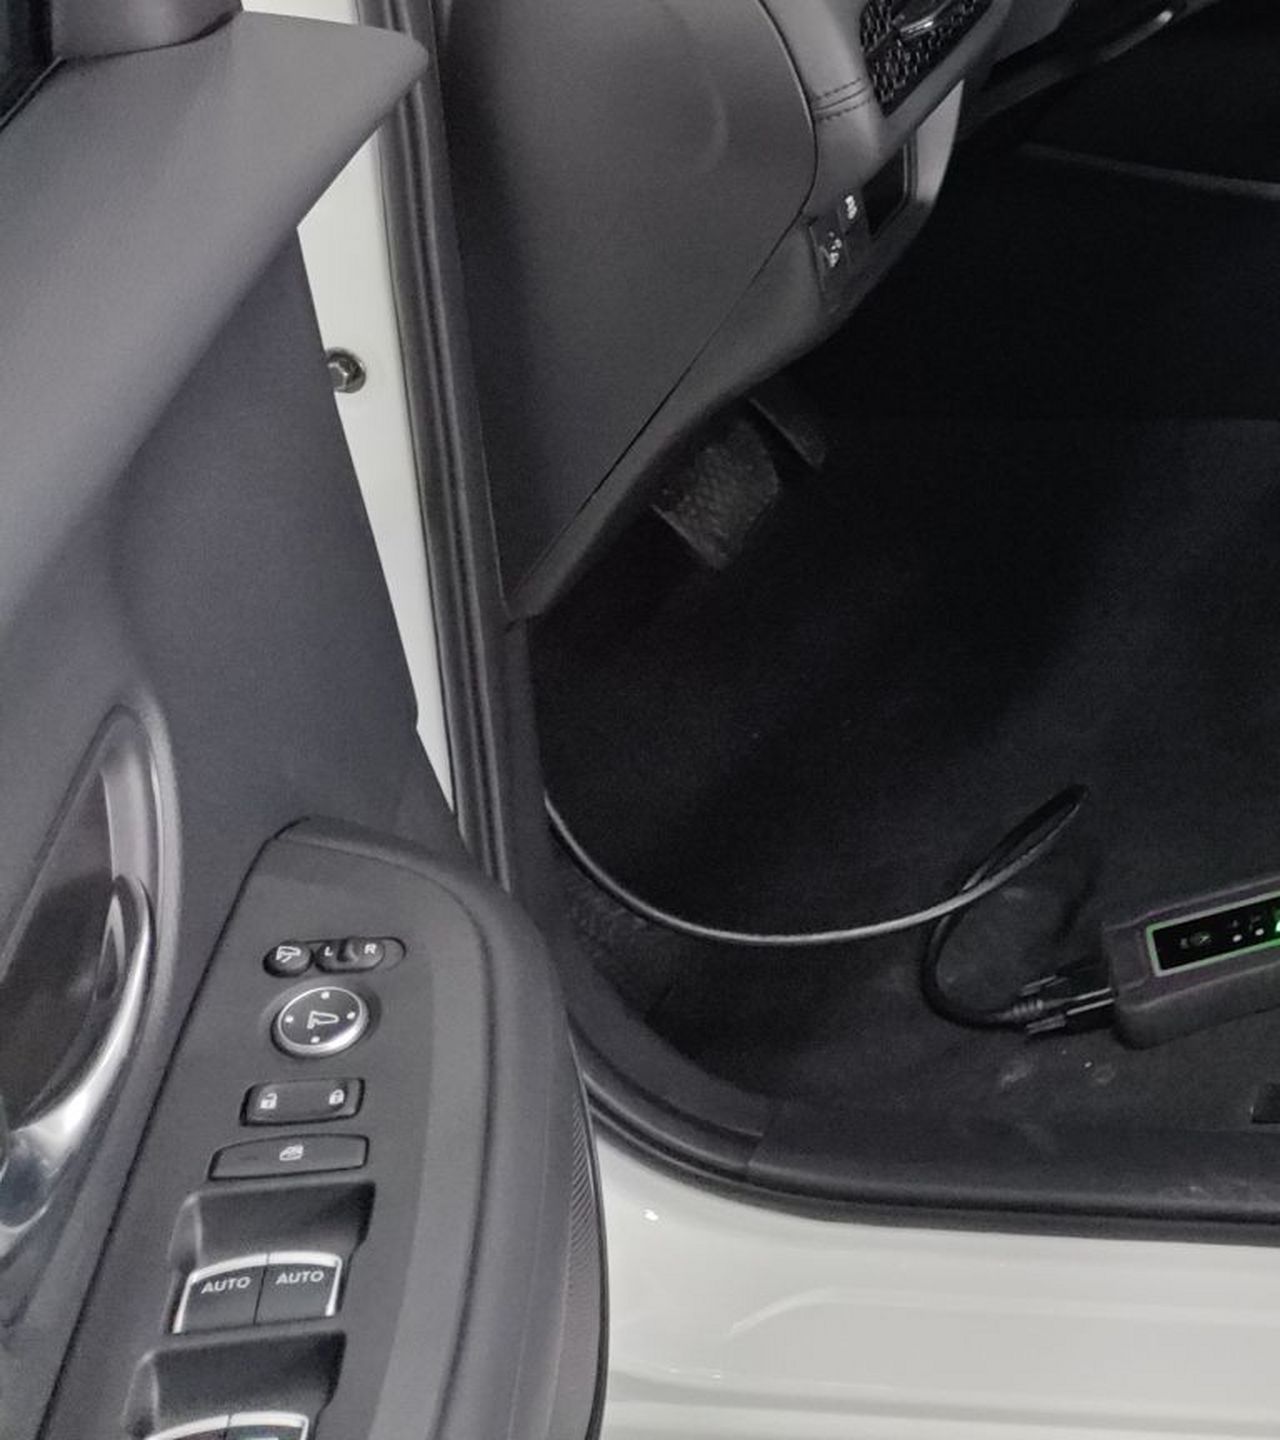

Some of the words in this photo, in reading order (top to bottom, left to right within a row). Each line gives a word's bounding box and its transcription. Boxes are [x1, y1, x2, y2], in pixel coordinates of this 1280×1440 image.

[323, 945, 333, 957] L
[364, 943, 377, 955] R
[200, 1276, 252, 1294] AUTO
[275, 1269, 325, 1285] AUTO
